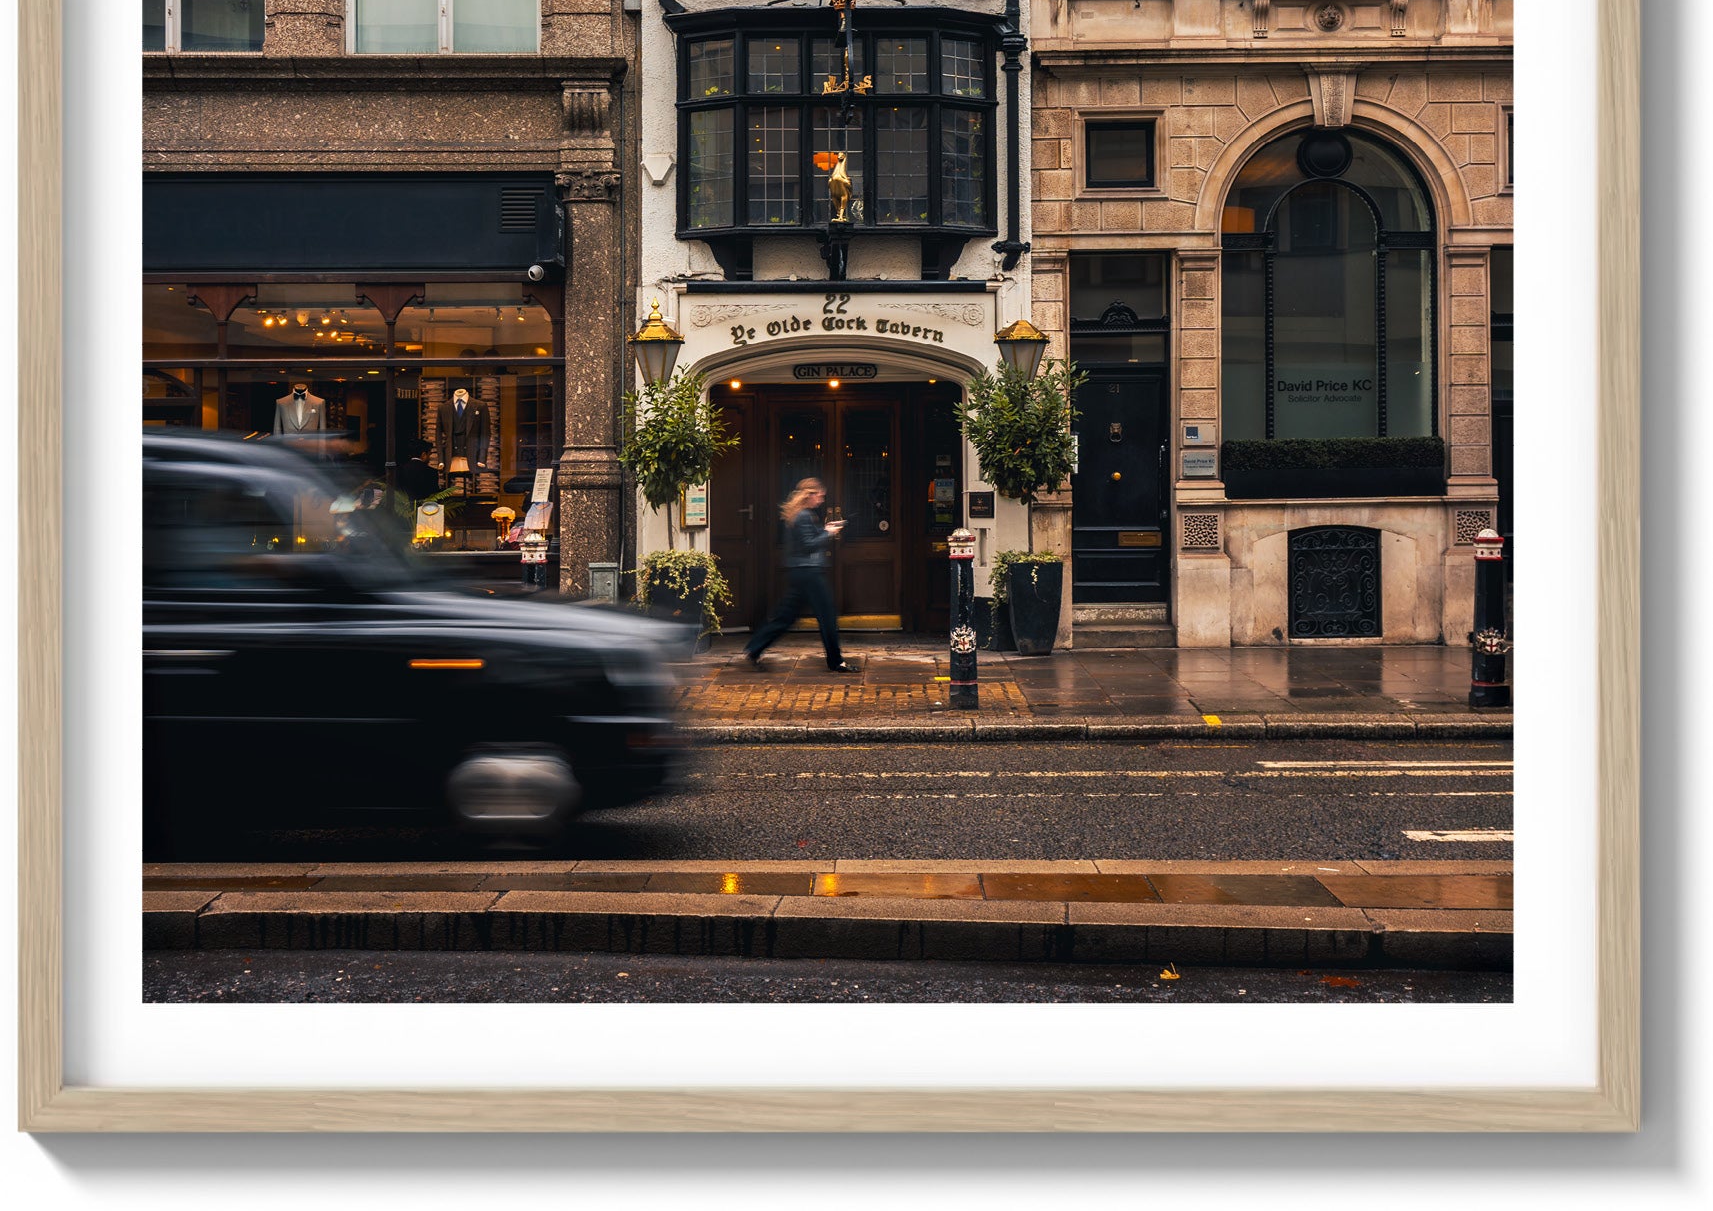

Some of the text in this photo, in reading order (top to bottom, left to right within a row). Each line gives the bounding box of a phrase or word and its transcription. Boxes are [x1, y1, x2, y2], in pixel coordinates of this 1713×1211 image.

[822, 293, 851, 314] 22
[730, 315, 945, 347] Ye Olde Cock Tavern
[796, 366, 873, 377] GIN PALACE
[1108, 383, 1120, 393] 21
[1277, 379, 1373, 392] David Price KC
[1288, 394, 1362, 403] Solicitor Advocate
